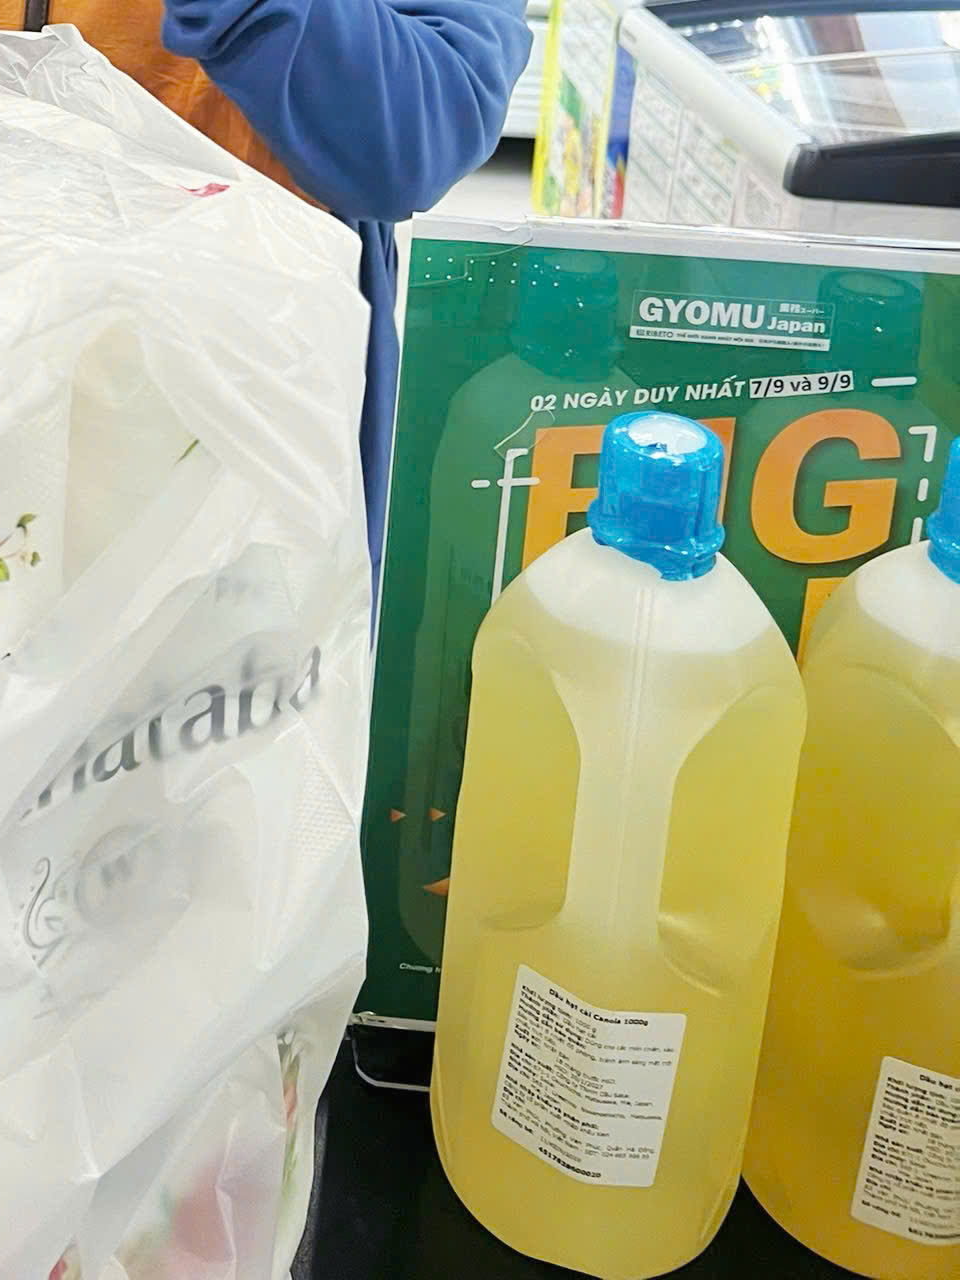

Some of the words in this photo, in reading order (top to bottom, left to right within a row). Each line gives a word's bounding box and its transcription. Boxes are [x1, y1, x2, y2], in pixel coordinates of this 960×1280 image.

[638, 296, 766, 331] GYOMU
[766, 316, 827, 335] Japan
[530, 394, 557, 411] 02
[563, 383, 627, 409] NGÀY
[633, 385, 680, 406] DUY
[685, 374, 746, 402] NHẤT
[751, 376, 786, 397] 7/9
[790, 373, 815, 394] và
[818, 371, 852, 393] 9/9
